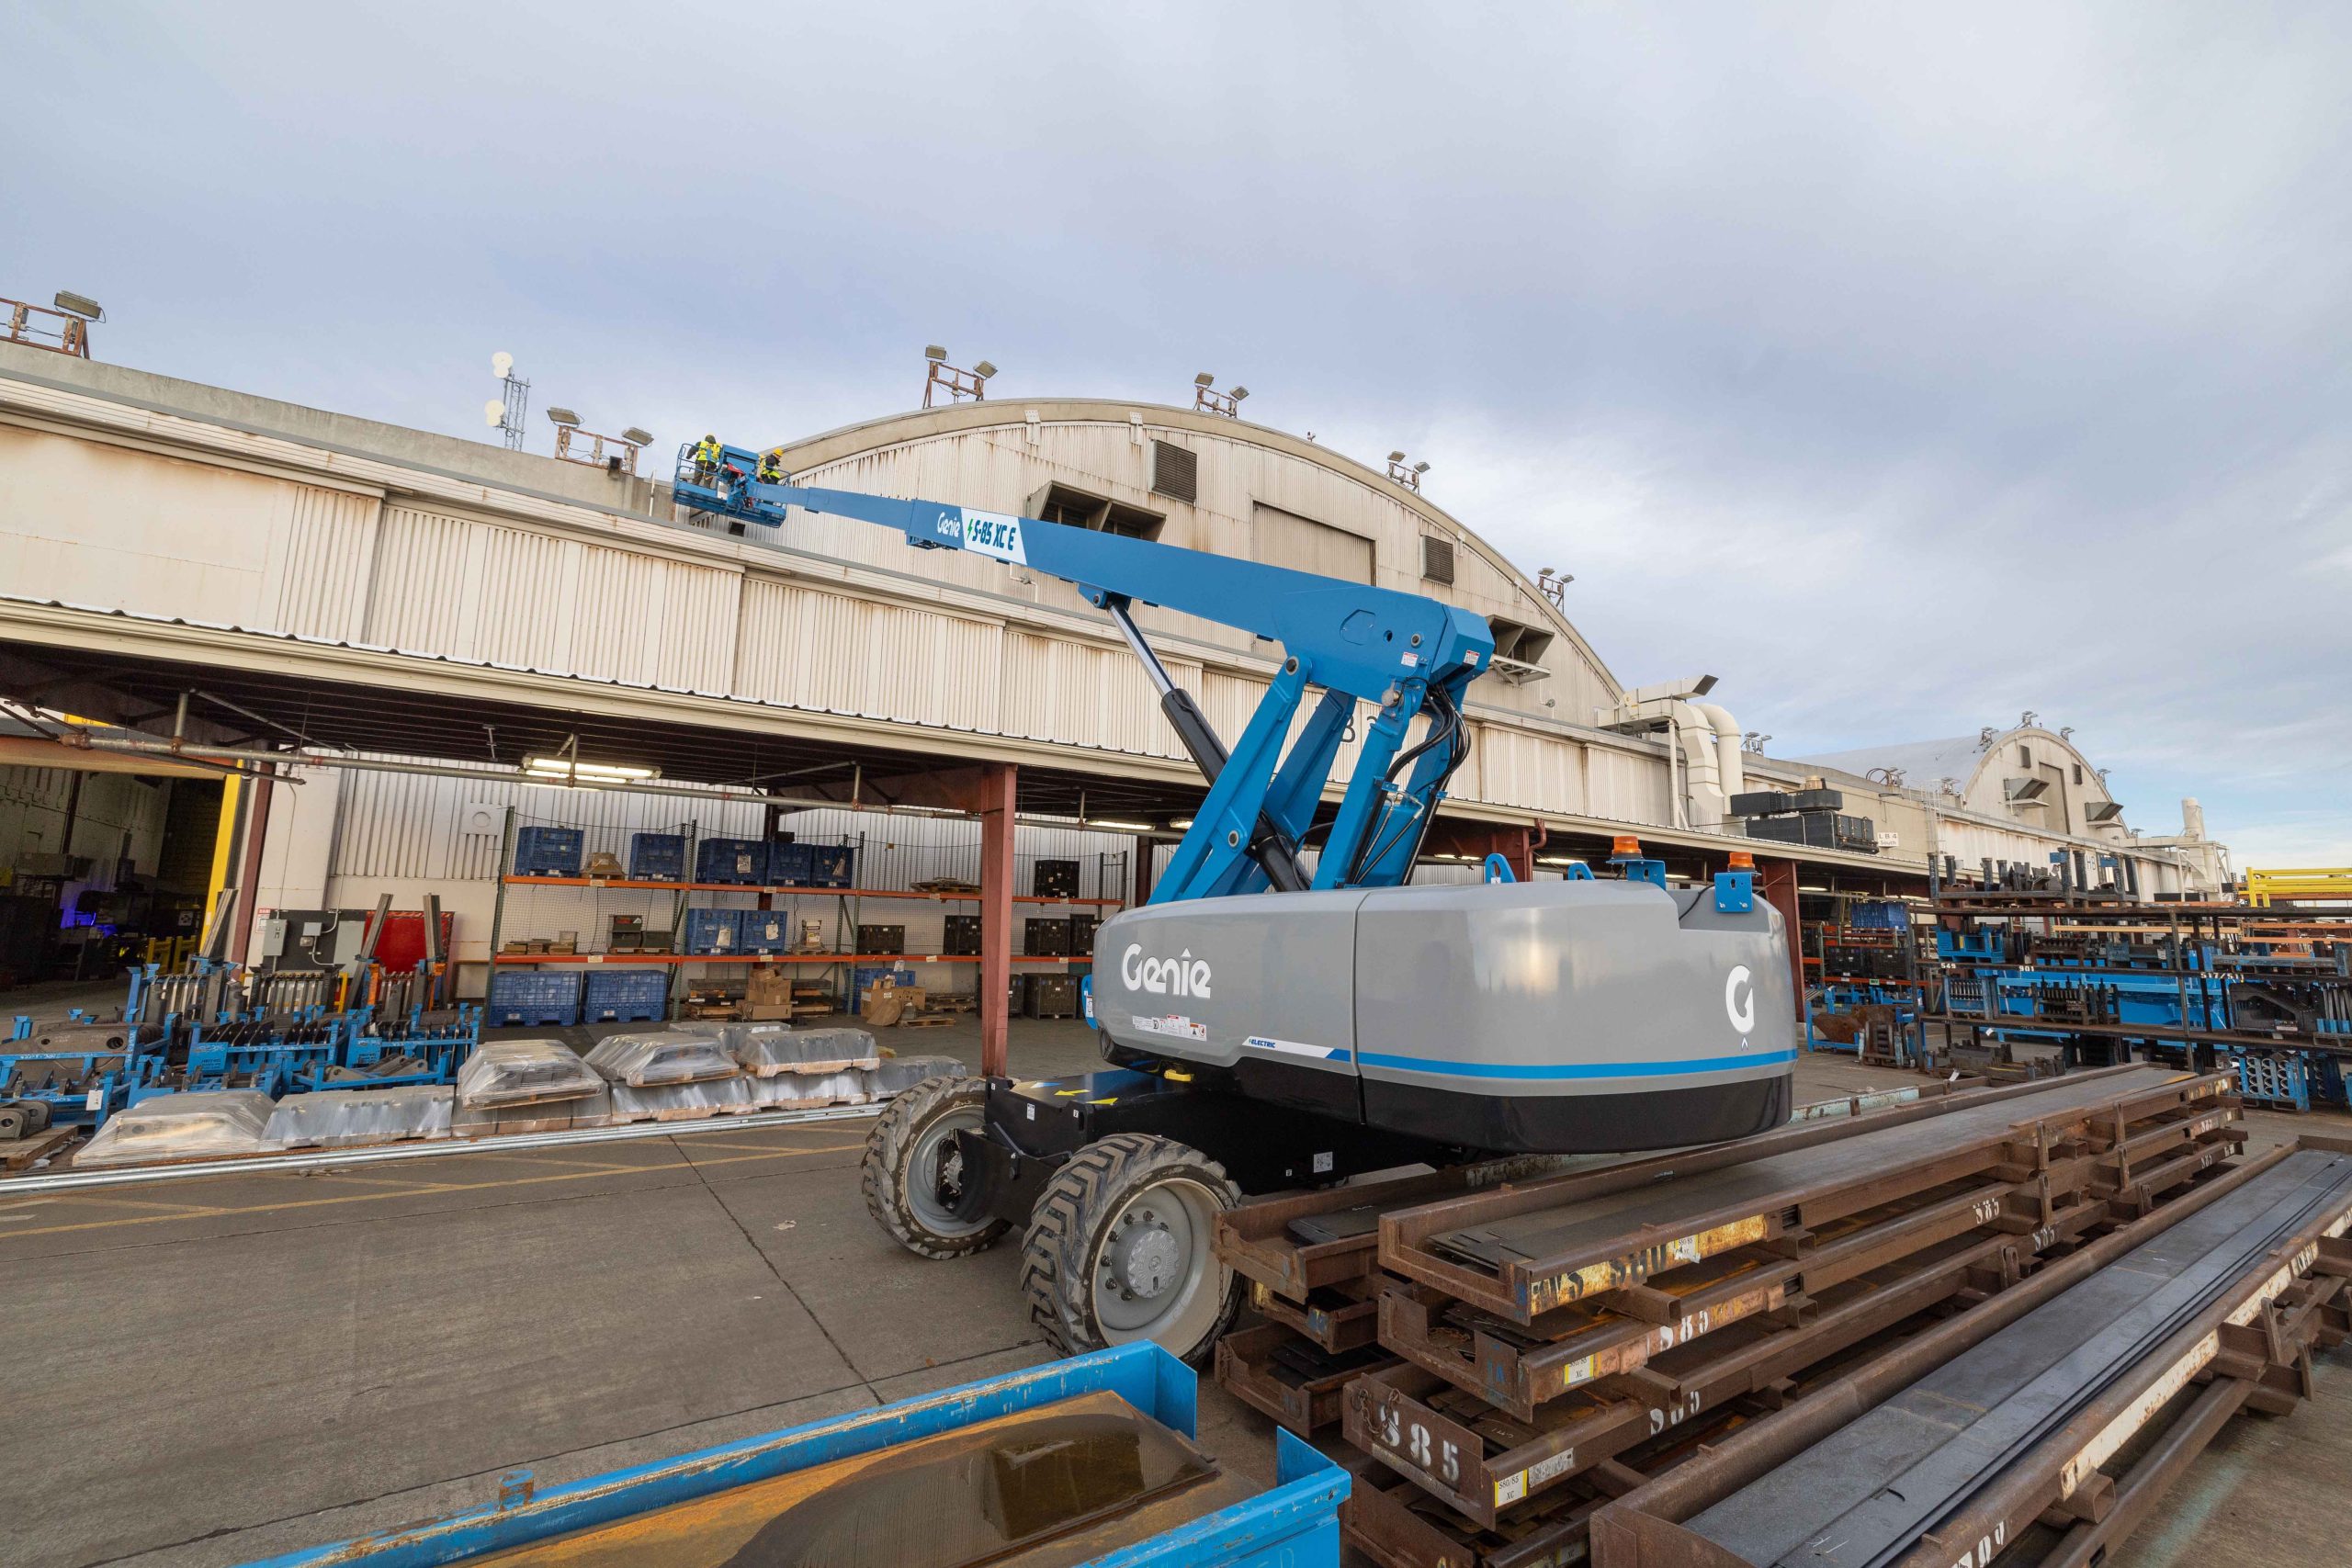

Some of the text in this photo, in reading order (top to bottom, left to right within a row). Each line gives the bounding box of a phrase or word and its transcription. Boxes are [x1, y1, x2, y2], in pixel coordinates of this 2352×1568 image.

[937, 512, 960, 537] Genie
[993, 524, 1007, 548] XC
[1008, 527, 1016, 550] E
[1122, 942, 1212, 998] Genie
[1725, 964, 1755, 1034] G
[1250, 1039, 1276, 1048] ELECTRIC
[1380, 1404, 1459, 1483] S85
[1506, 1490, 1515, 1500] XC
